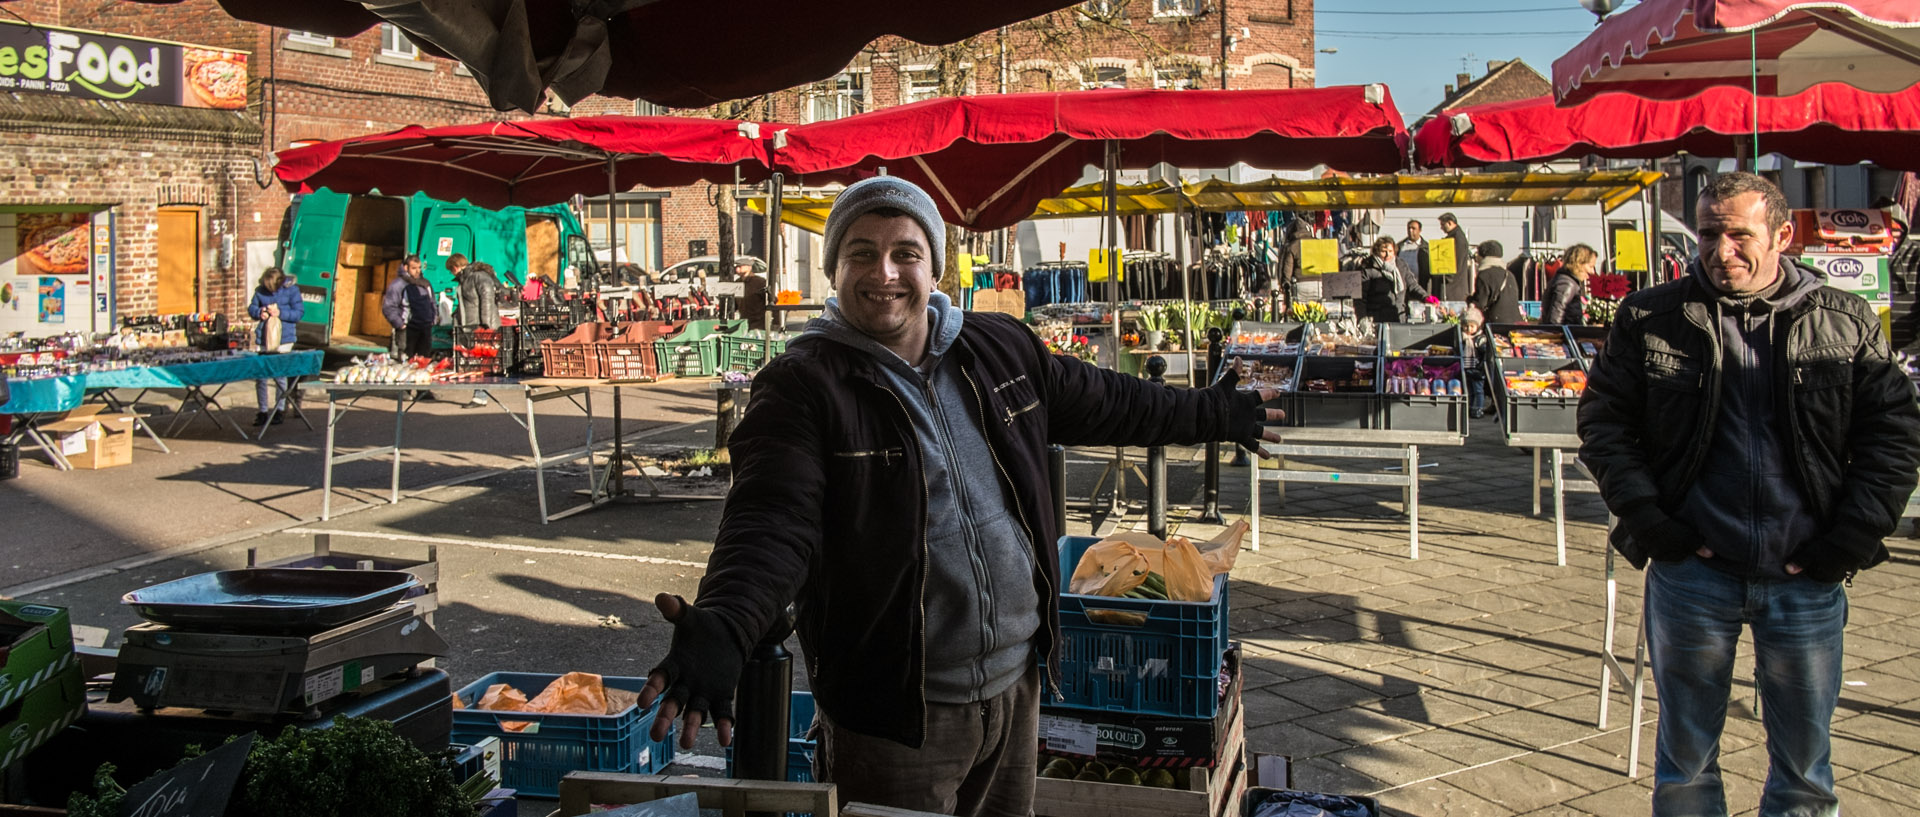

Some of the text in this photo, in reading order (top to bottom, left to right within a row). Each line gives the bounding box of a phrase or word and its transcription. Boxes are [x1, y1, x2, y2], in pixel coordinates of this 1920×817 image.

[20, 78, 46, 90] PANINI
[50, 81, 71, 93] PIZZA
[1833, 212, 1867, 225] Croky
[212, 219, 228, 234] 33
[1830, 260, 1862, 276] Croky
